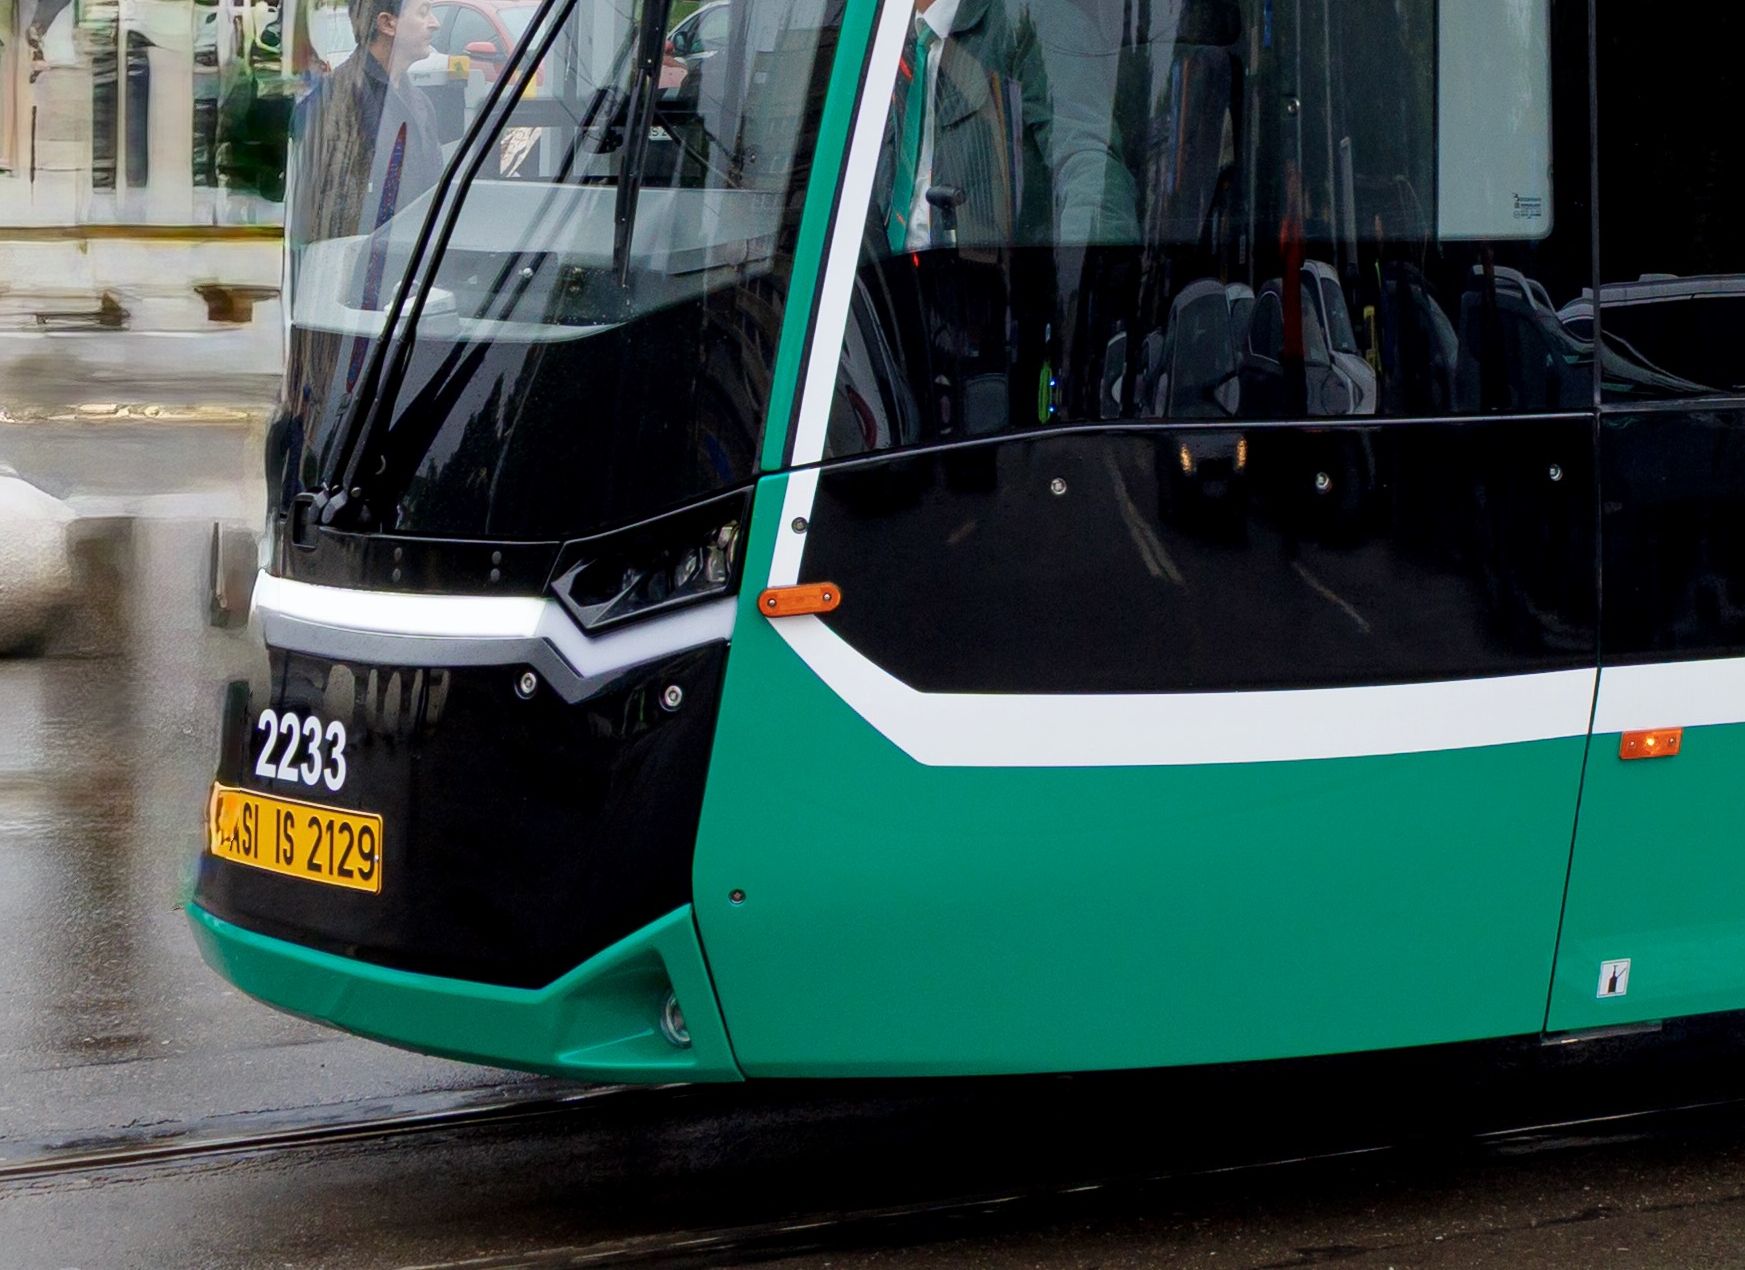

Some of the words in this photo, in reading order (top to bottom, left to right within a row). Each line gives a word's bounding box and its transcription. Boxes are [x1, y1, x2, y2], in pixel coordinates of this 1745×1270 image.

[255, 708, 347, 792] 2233
[275, 807, 296, 866] IS
[307, 815, 377, 882] 2129
